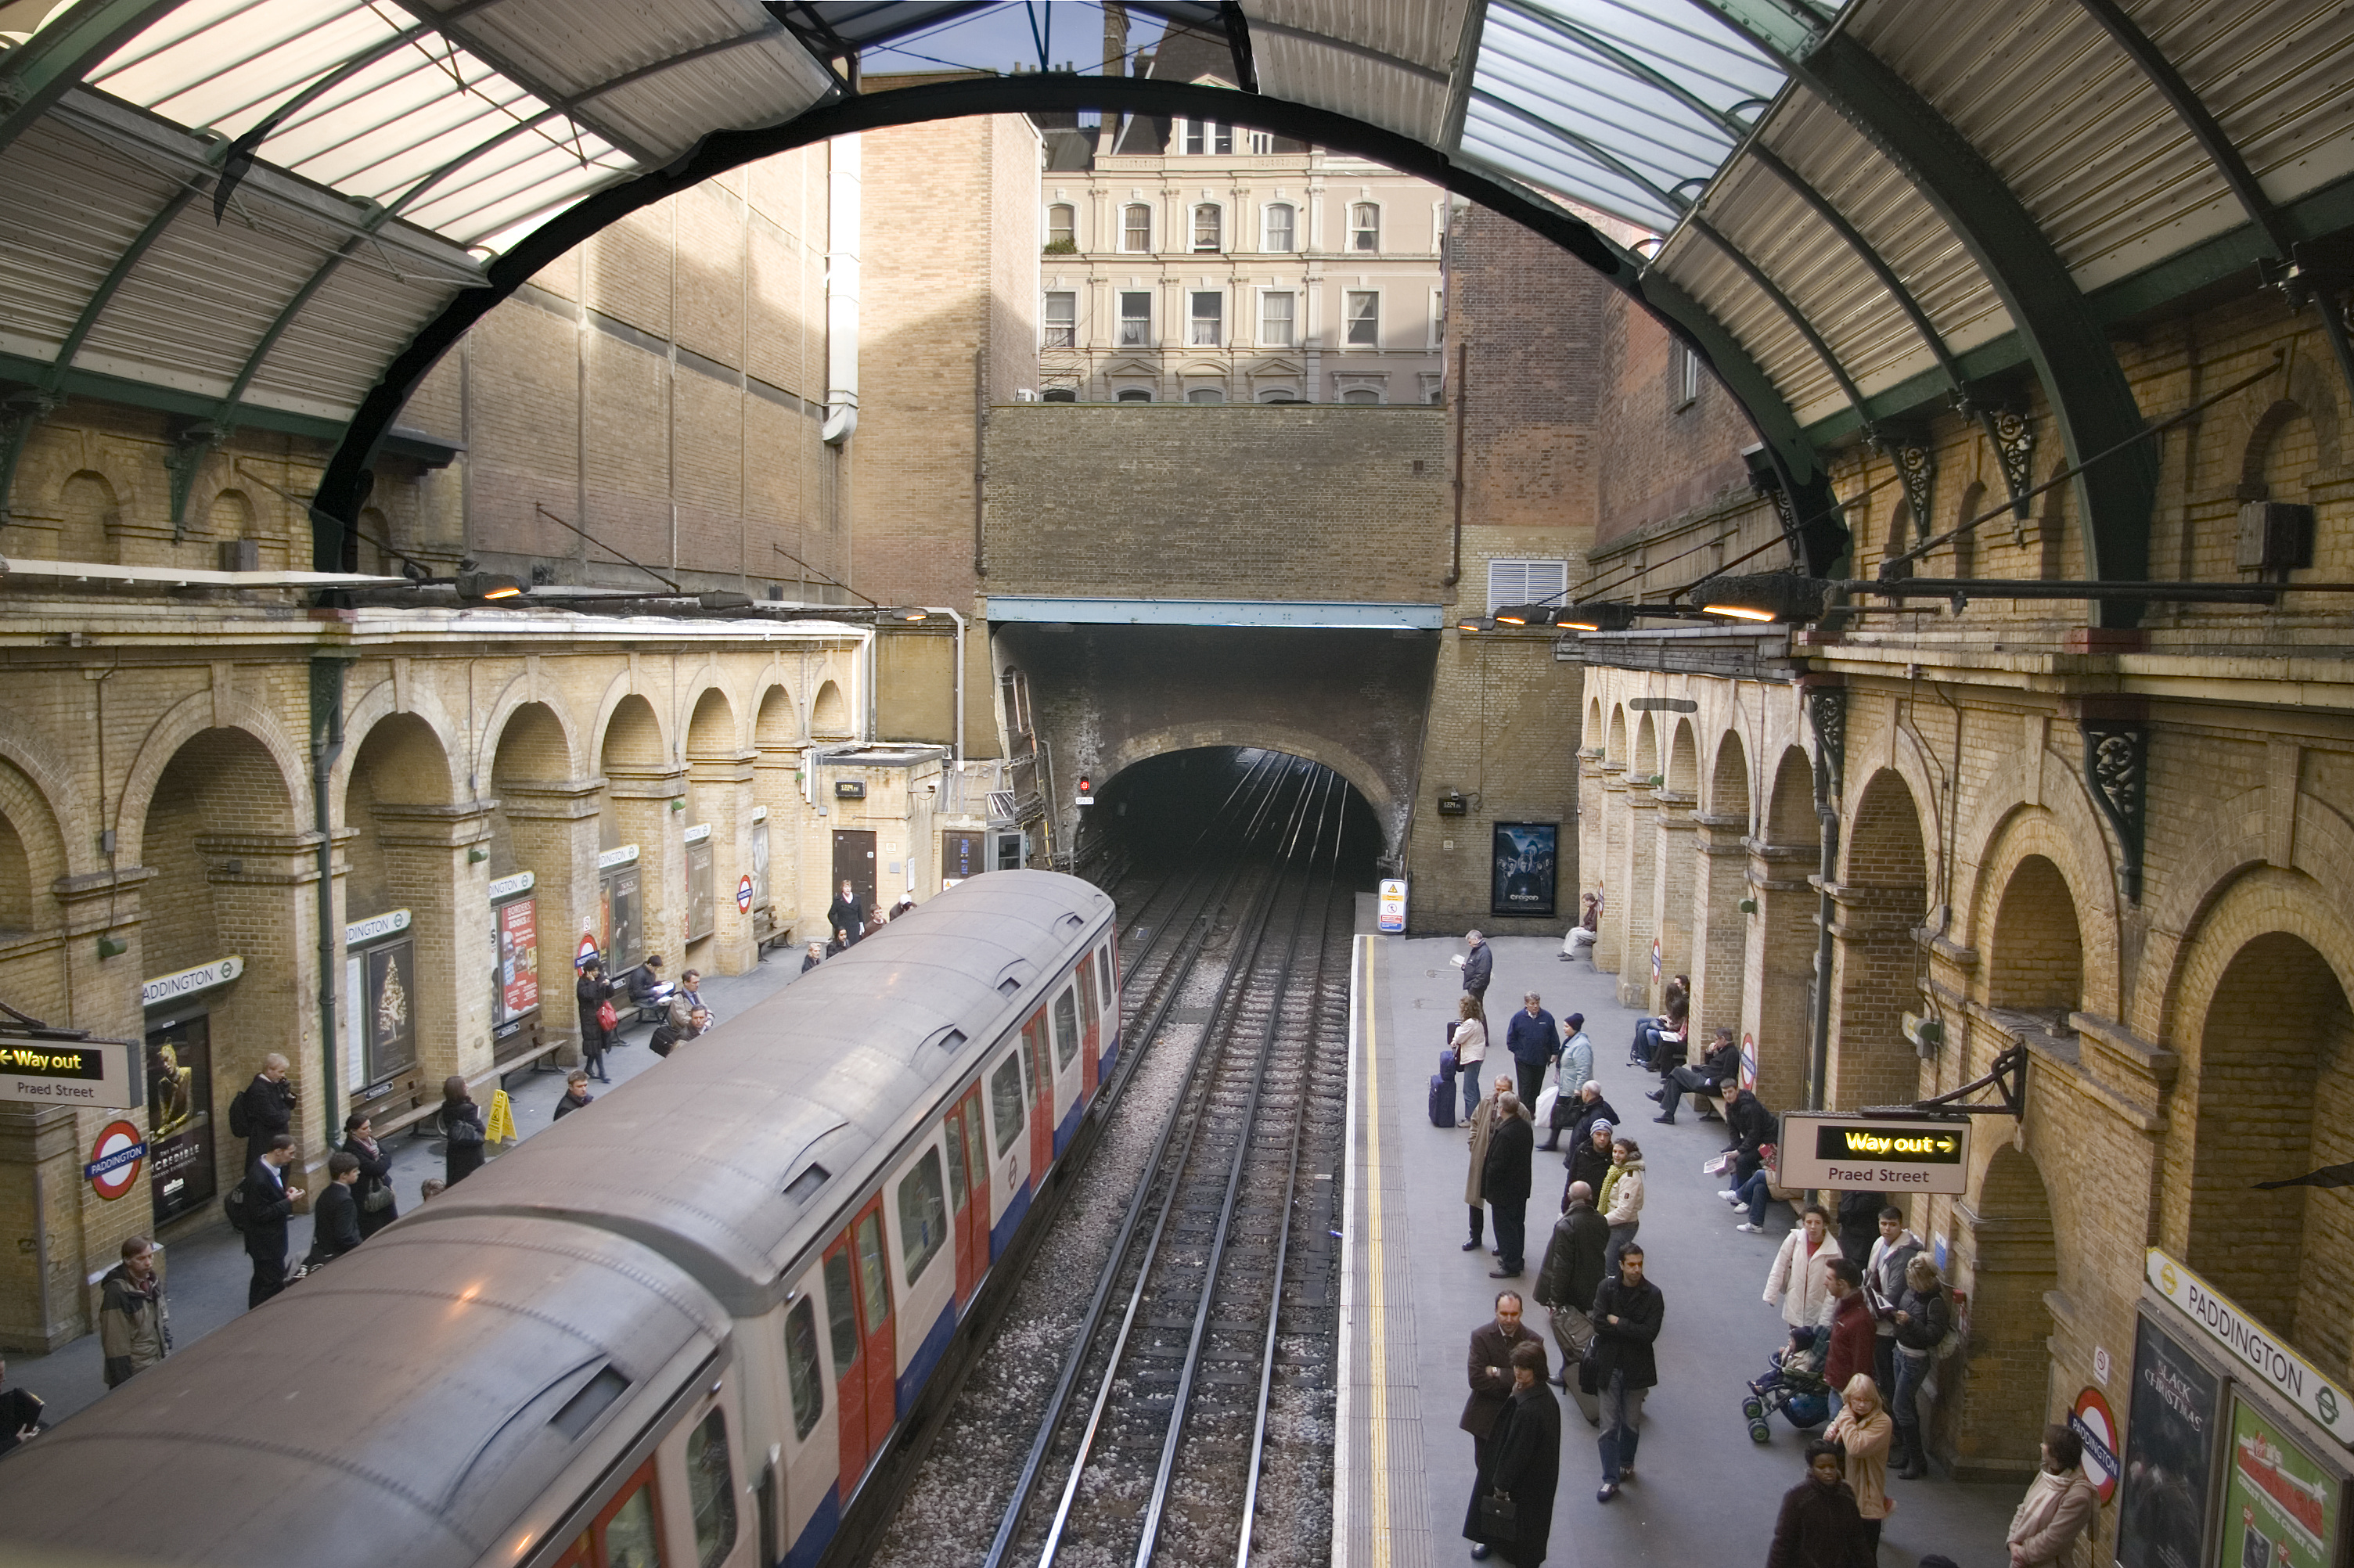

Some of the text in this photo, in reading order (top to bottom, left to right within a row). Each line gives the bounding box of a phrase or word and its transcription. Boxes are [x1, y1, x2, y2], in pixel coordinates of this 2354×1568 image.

[13, 1050, 82, 1070] Way out
[18, 1082, 94, 1098] Praed Street
[1845, 1132, 1933, 1155] Way out
[91, 1145, 142, 1174] PADDINGTON
[1829, 1167, 1929, 1183] Praed Street
[2189, 1284, 2302, 1397] PADDINGTON
[2158, 1360, 2190, 1403] BLACK
[2145, 1368, 2203, 1432] CHRISTMAS
[2073, 1418, 2118, 1476] PADDINGTON
